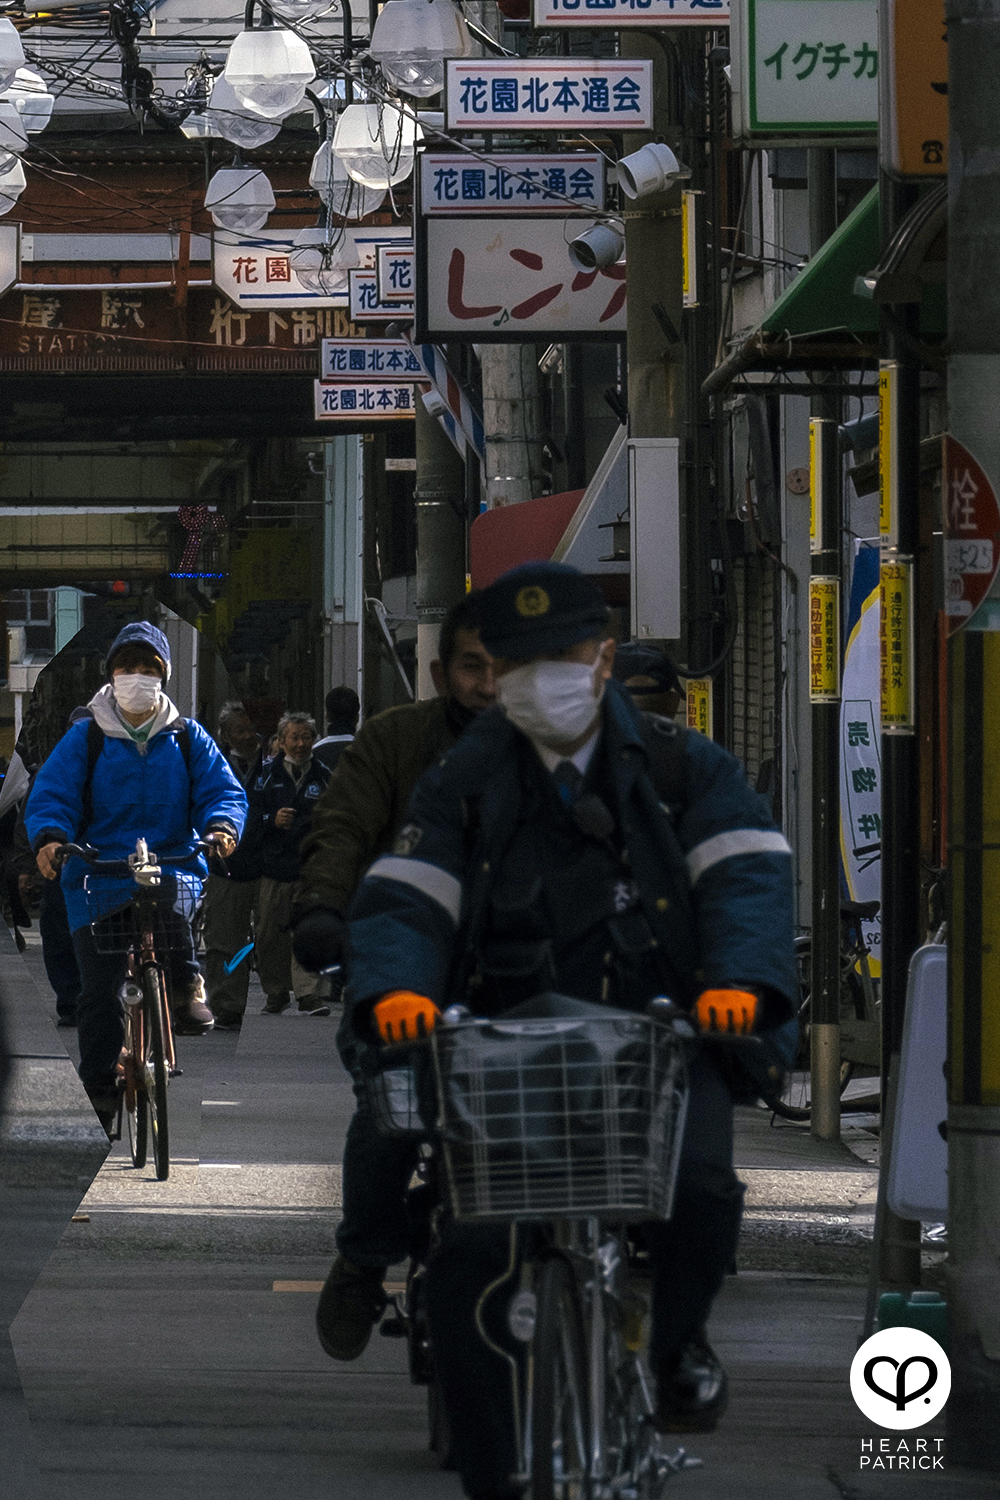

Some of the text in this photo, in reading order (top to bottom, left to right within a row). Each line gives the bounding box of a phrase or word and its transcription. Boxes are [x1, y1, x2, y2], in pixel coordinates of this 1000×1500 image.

[458, 75, 642, 116] 花園北本通会
[433, 167, 596, 203] 花園北本通会
[321, 387, 414, 411] 花園北本通
